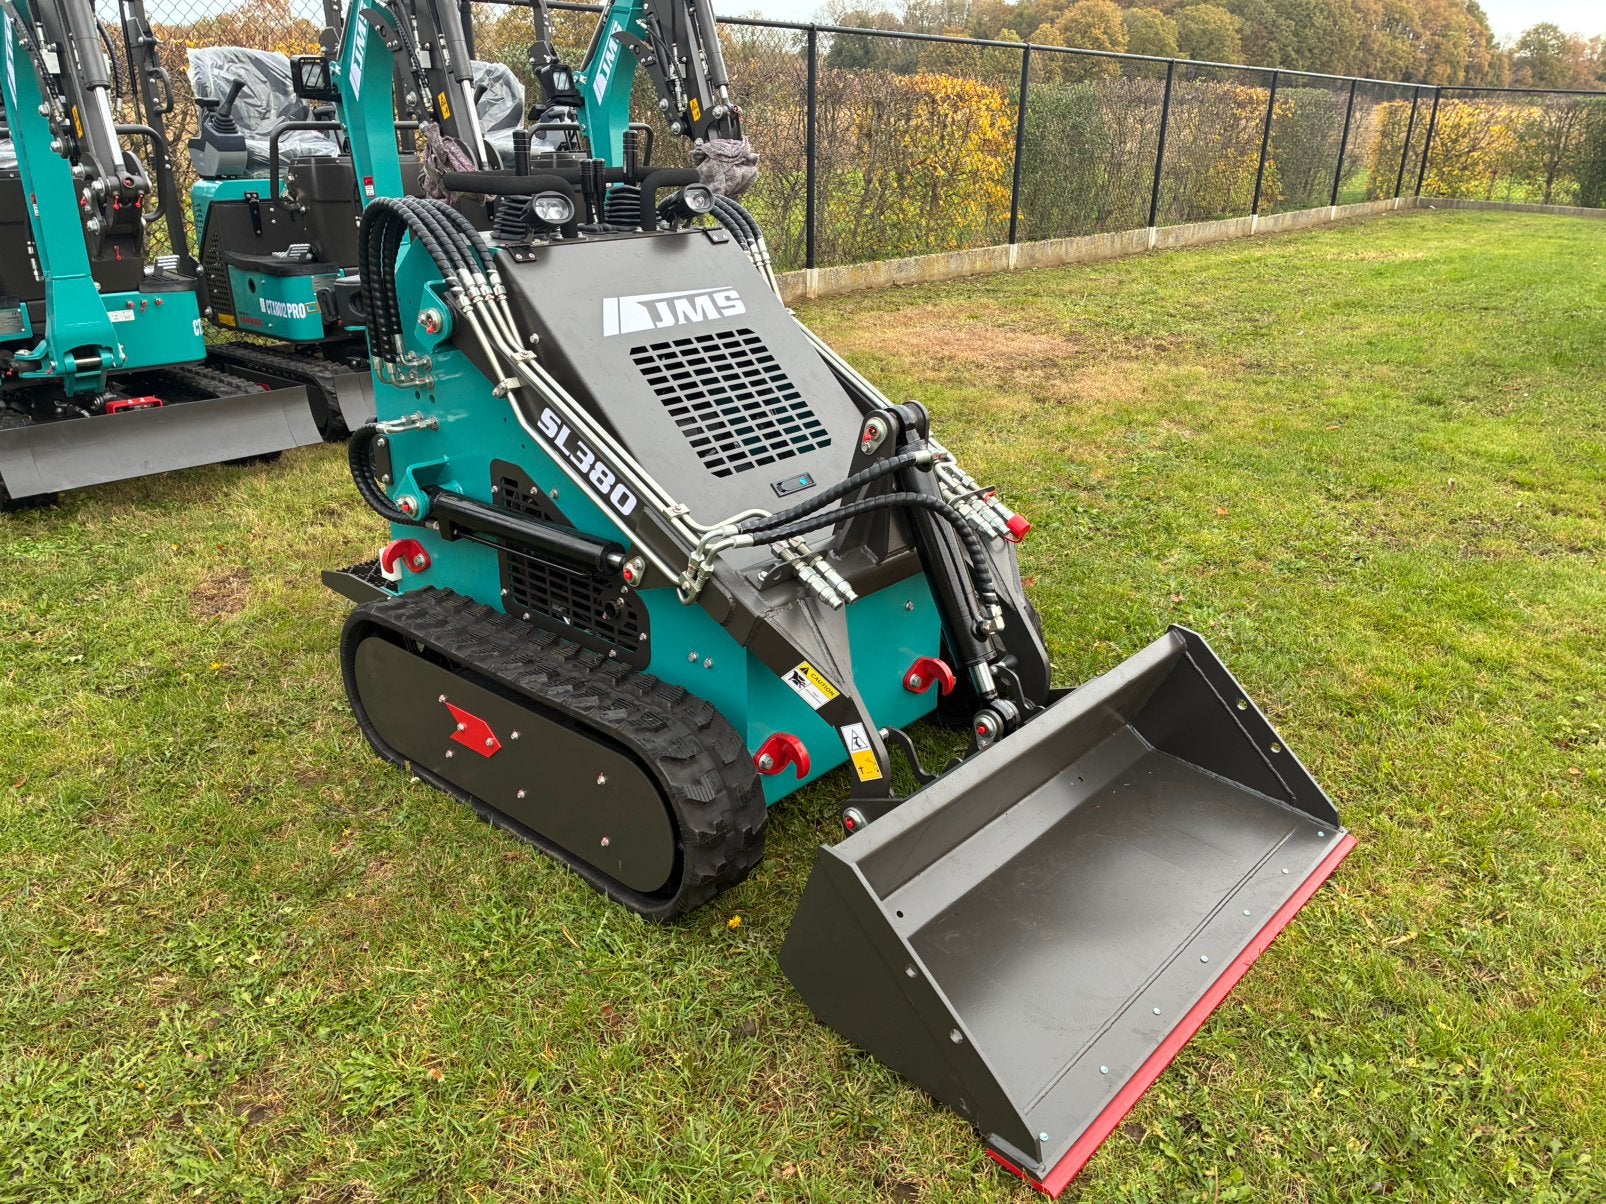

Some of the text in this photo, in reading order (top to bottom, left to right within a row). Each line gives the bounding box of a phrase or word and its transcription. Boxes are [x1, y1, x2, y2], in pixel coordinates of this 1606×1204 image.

[654, 289, 747, 329] JMS
[537, 407, 638, 516] SL380
[810, 673, 836, 697] CAUTION
